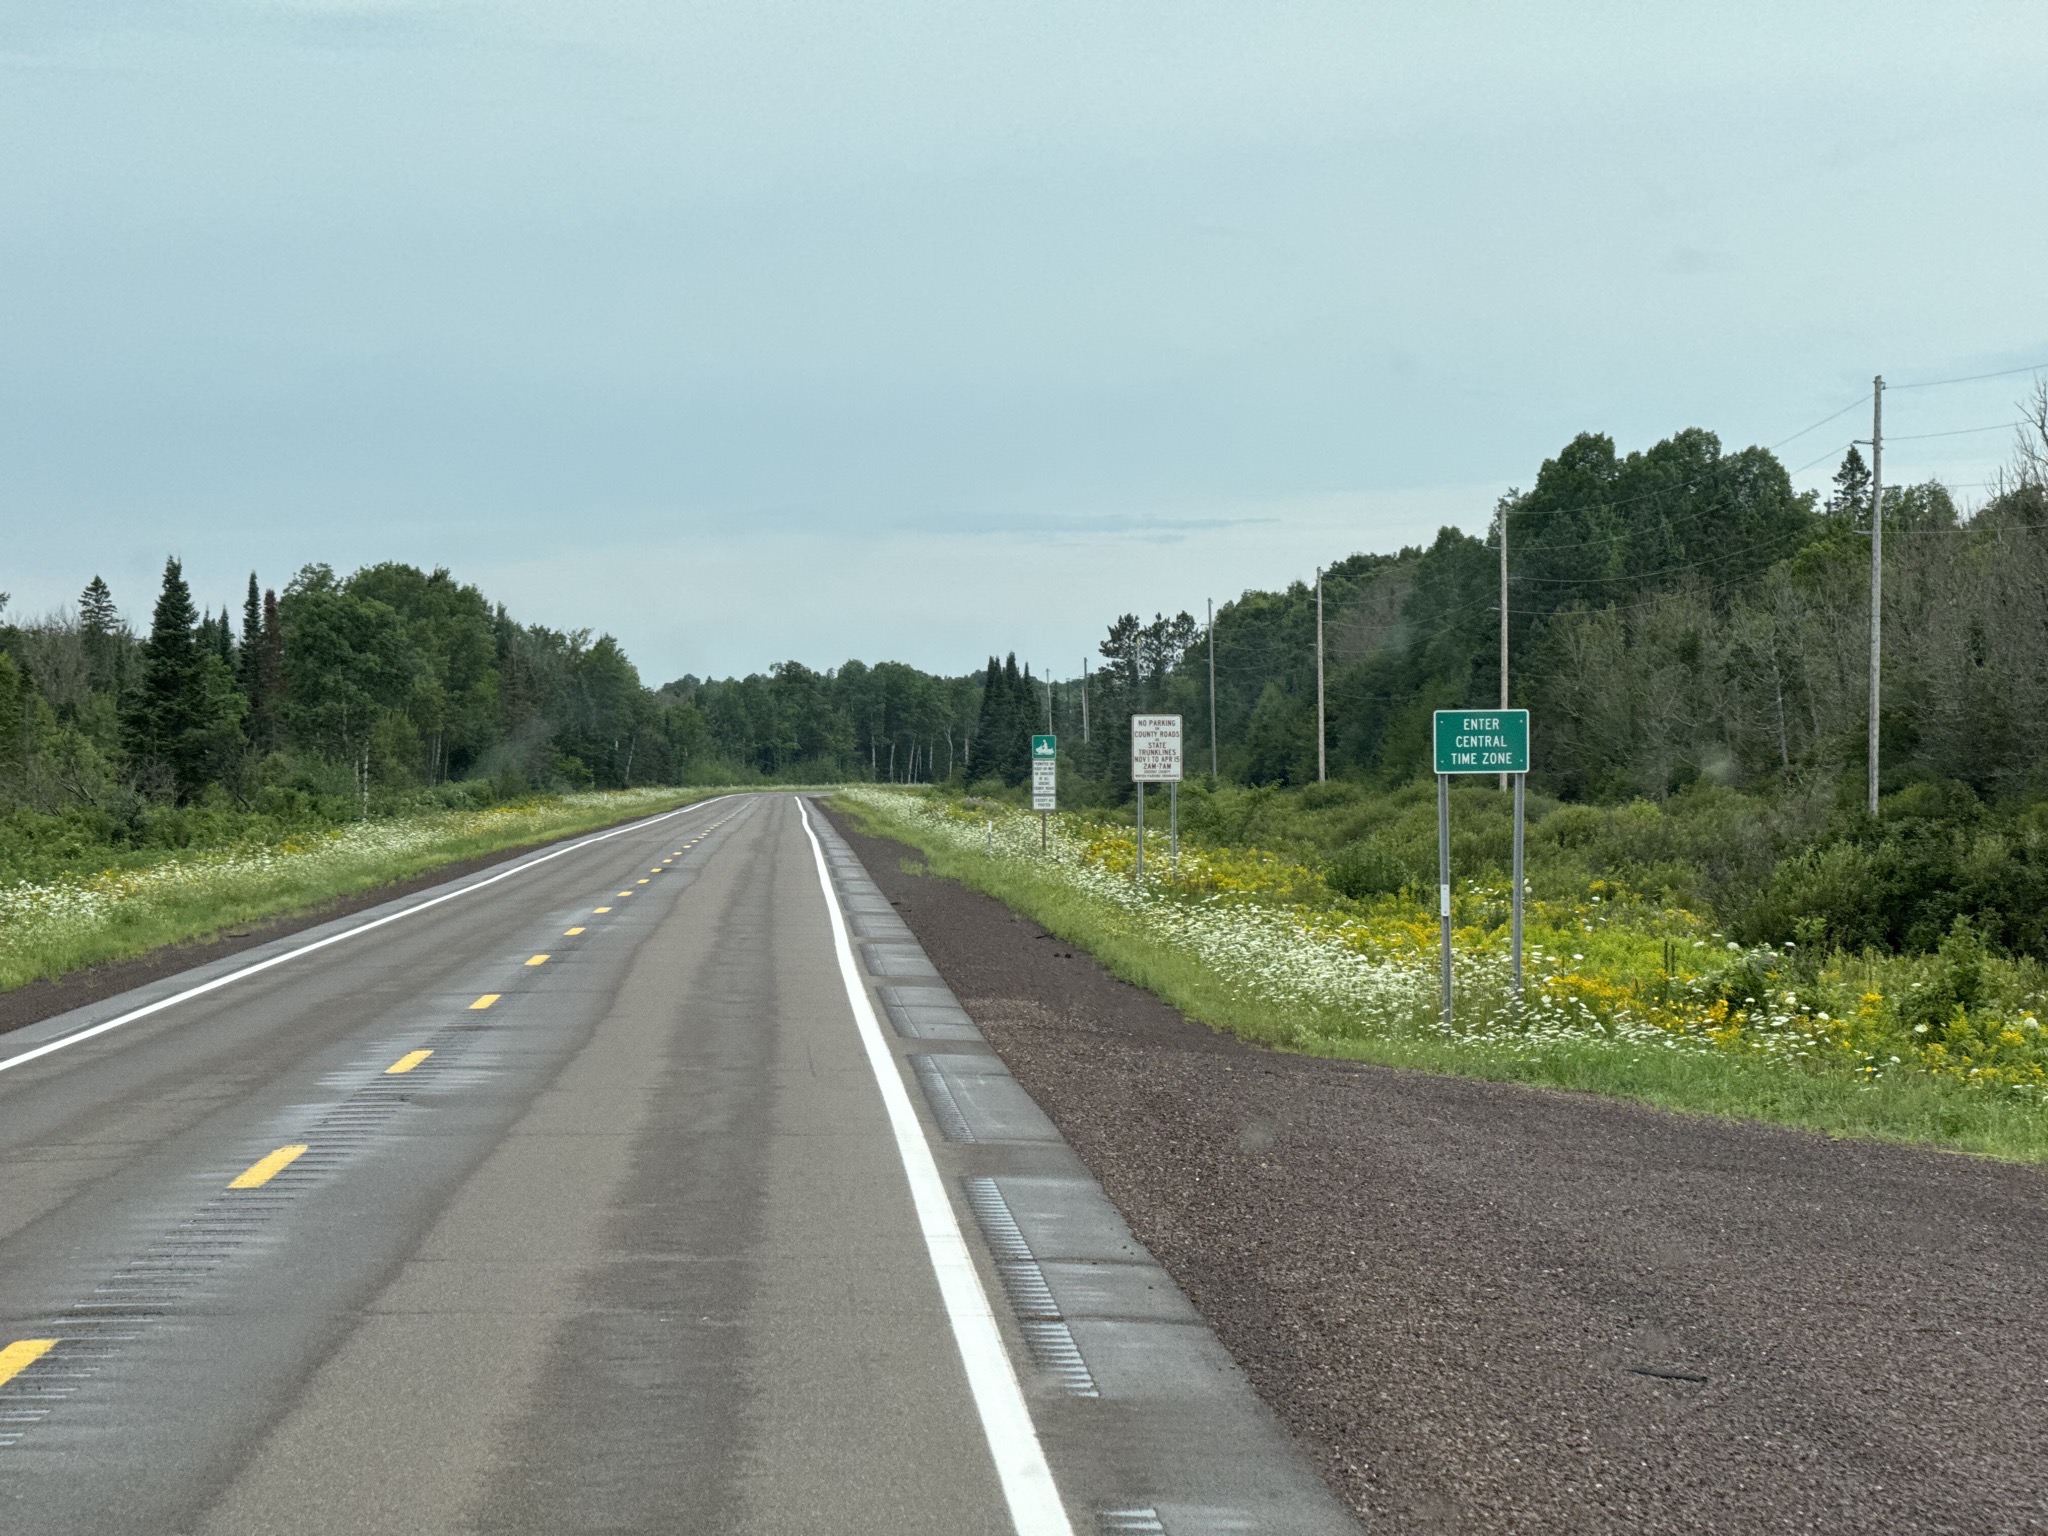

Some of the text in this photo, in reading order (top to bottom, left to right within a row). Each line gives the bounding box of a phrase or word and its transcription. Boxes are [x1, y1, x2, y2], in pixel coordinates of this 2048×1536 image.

[1464, 718, 1499, 730] ENTER
[1456, 736, 1507, 748] CENTRAL
[1451, 752, 1512, 765] TIME ZONE
